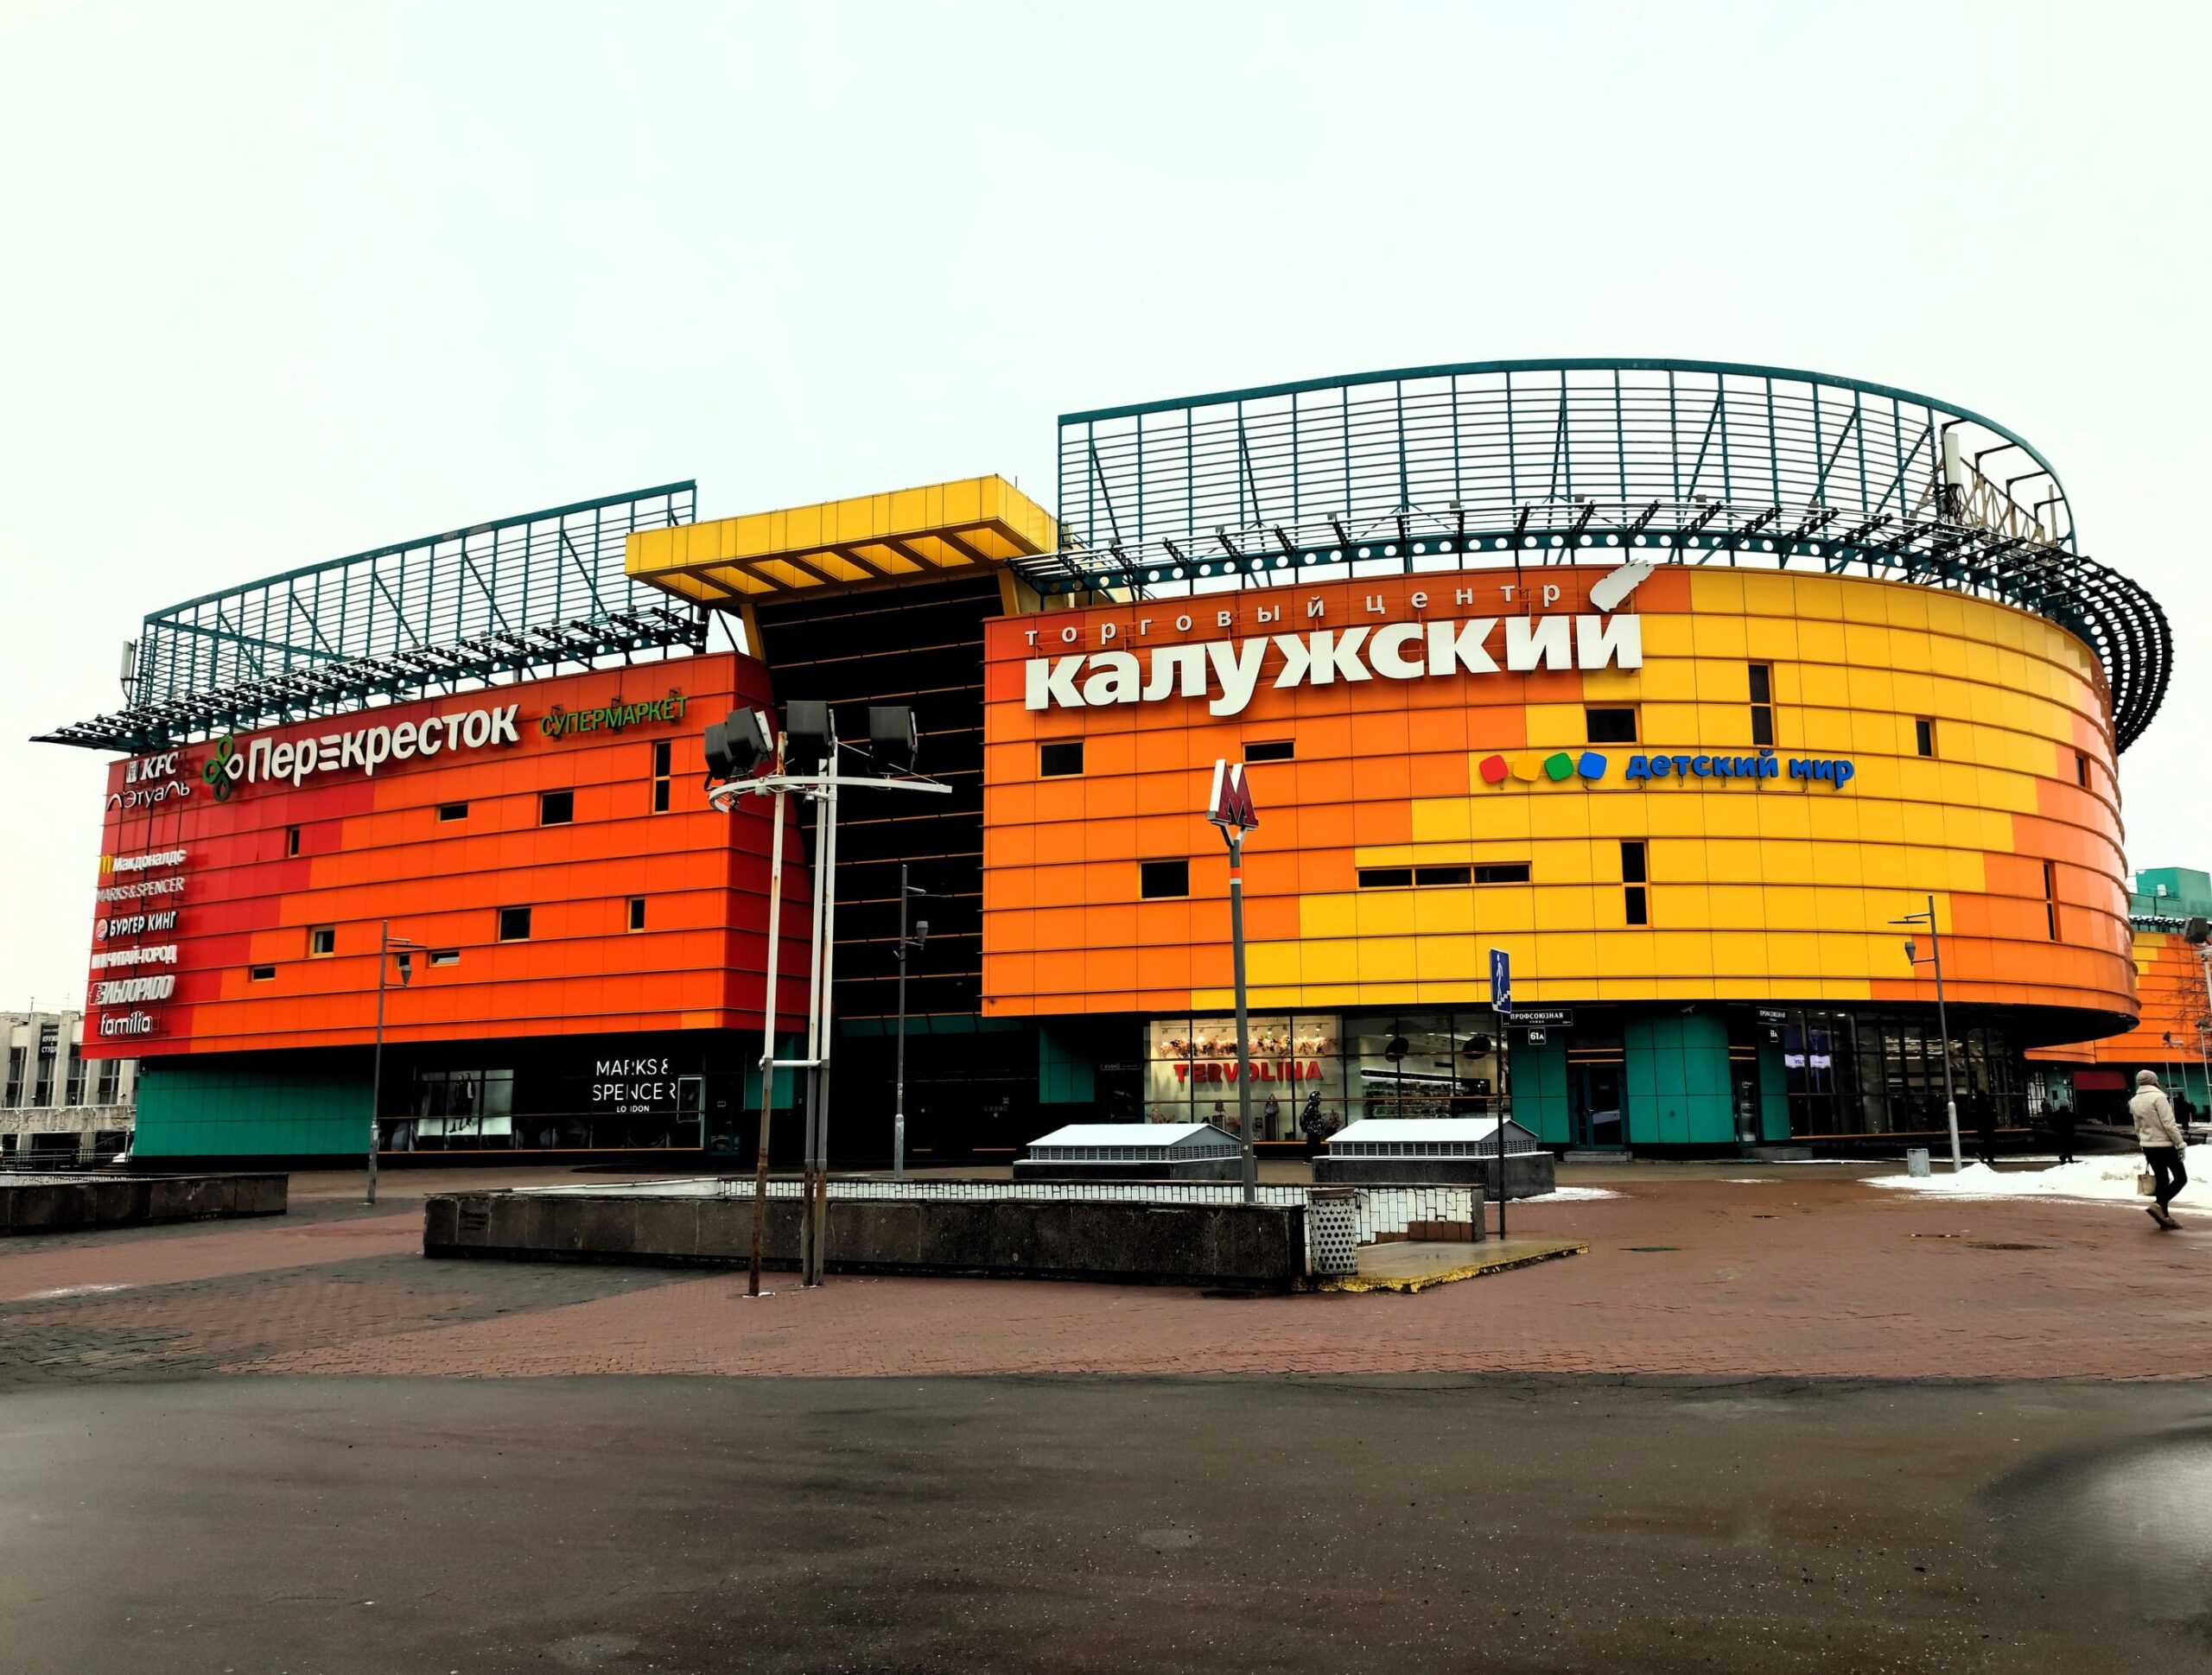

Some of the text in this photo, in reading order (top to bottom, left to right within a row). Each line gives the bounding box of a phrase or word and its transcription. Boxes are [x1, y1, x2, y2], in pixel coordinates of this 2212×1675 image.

[1025, 584, 1561, 647] торговый центр
[1025, 559, 1655, 717] калужский
[540, 696, 688, 737] СУПЕРМАРКЕТ
[140, 751, 179, 781] KFC
[1626, 750, 1854, 789] детский мир
[110, 916, 145, 936] БУРГЕР
[148, 911, 176, 931] КИНГ
[107, 945, 177, 967] ЧИТАЙ-ГОРОД
[100, 1010, 152, 1036] familia
[1173, 1061, 1324, 1083] TERVOLINA
[616, 1105, 650, 1113] LODON
